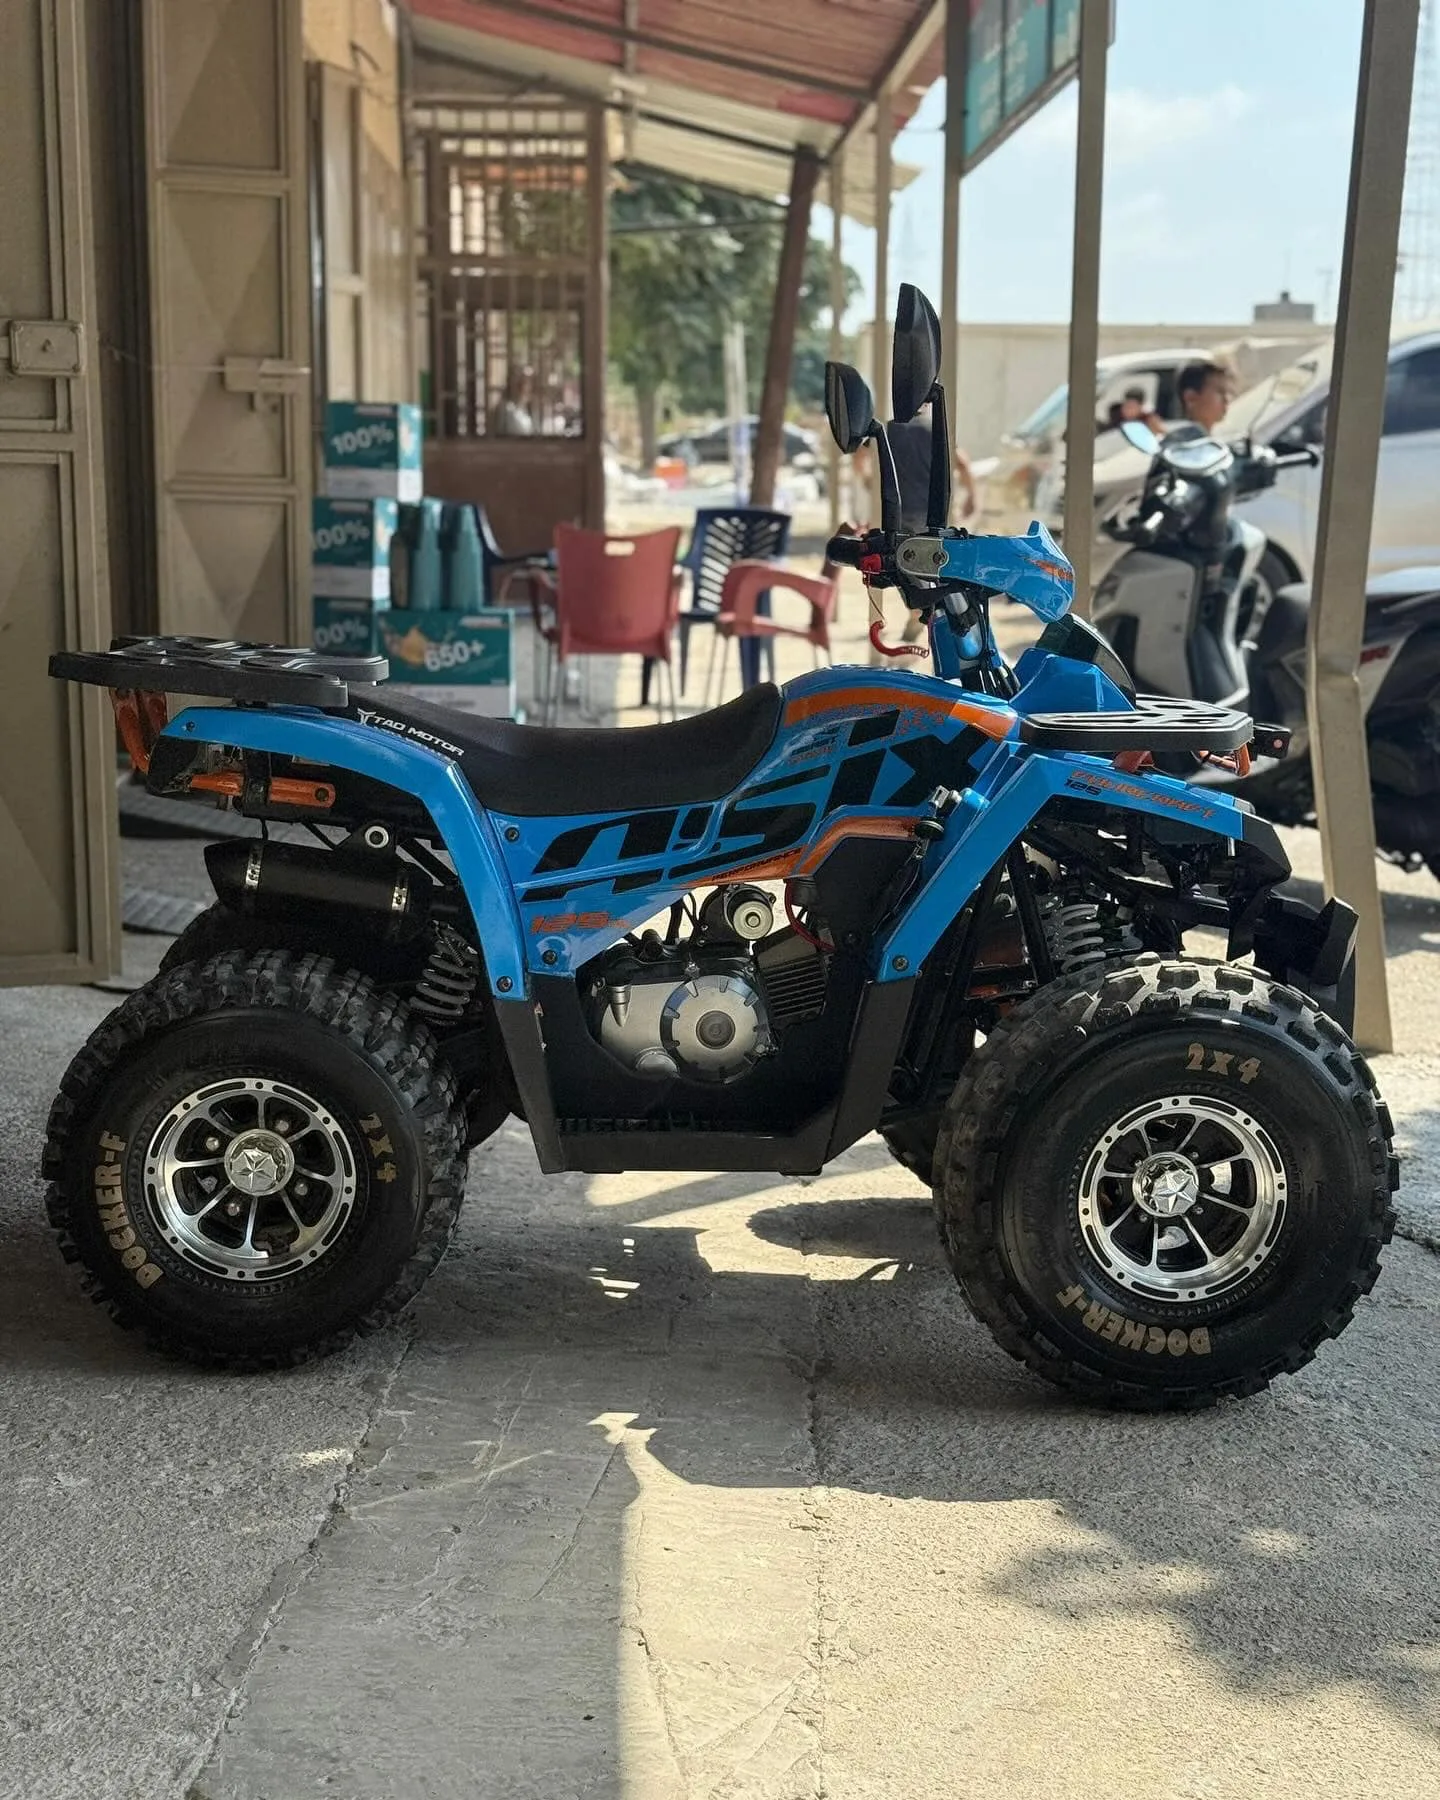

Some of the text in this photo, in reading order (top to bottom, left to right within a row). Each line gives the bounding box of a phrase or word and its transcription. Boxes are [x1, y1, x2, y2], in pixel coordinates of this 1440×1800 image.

[331, 421, 394, 456] 100%
[313, 519, 370, 550] 00%
[314, 617, 369, 648] 00%
[425, 638, 485, 672] 650+
[373, 715, 465, 756] TAO MOTOR
[95, 1129, 164, 1289] DOCKER-F
[1055, 1283, 1212, 1357] DOCKER-F
